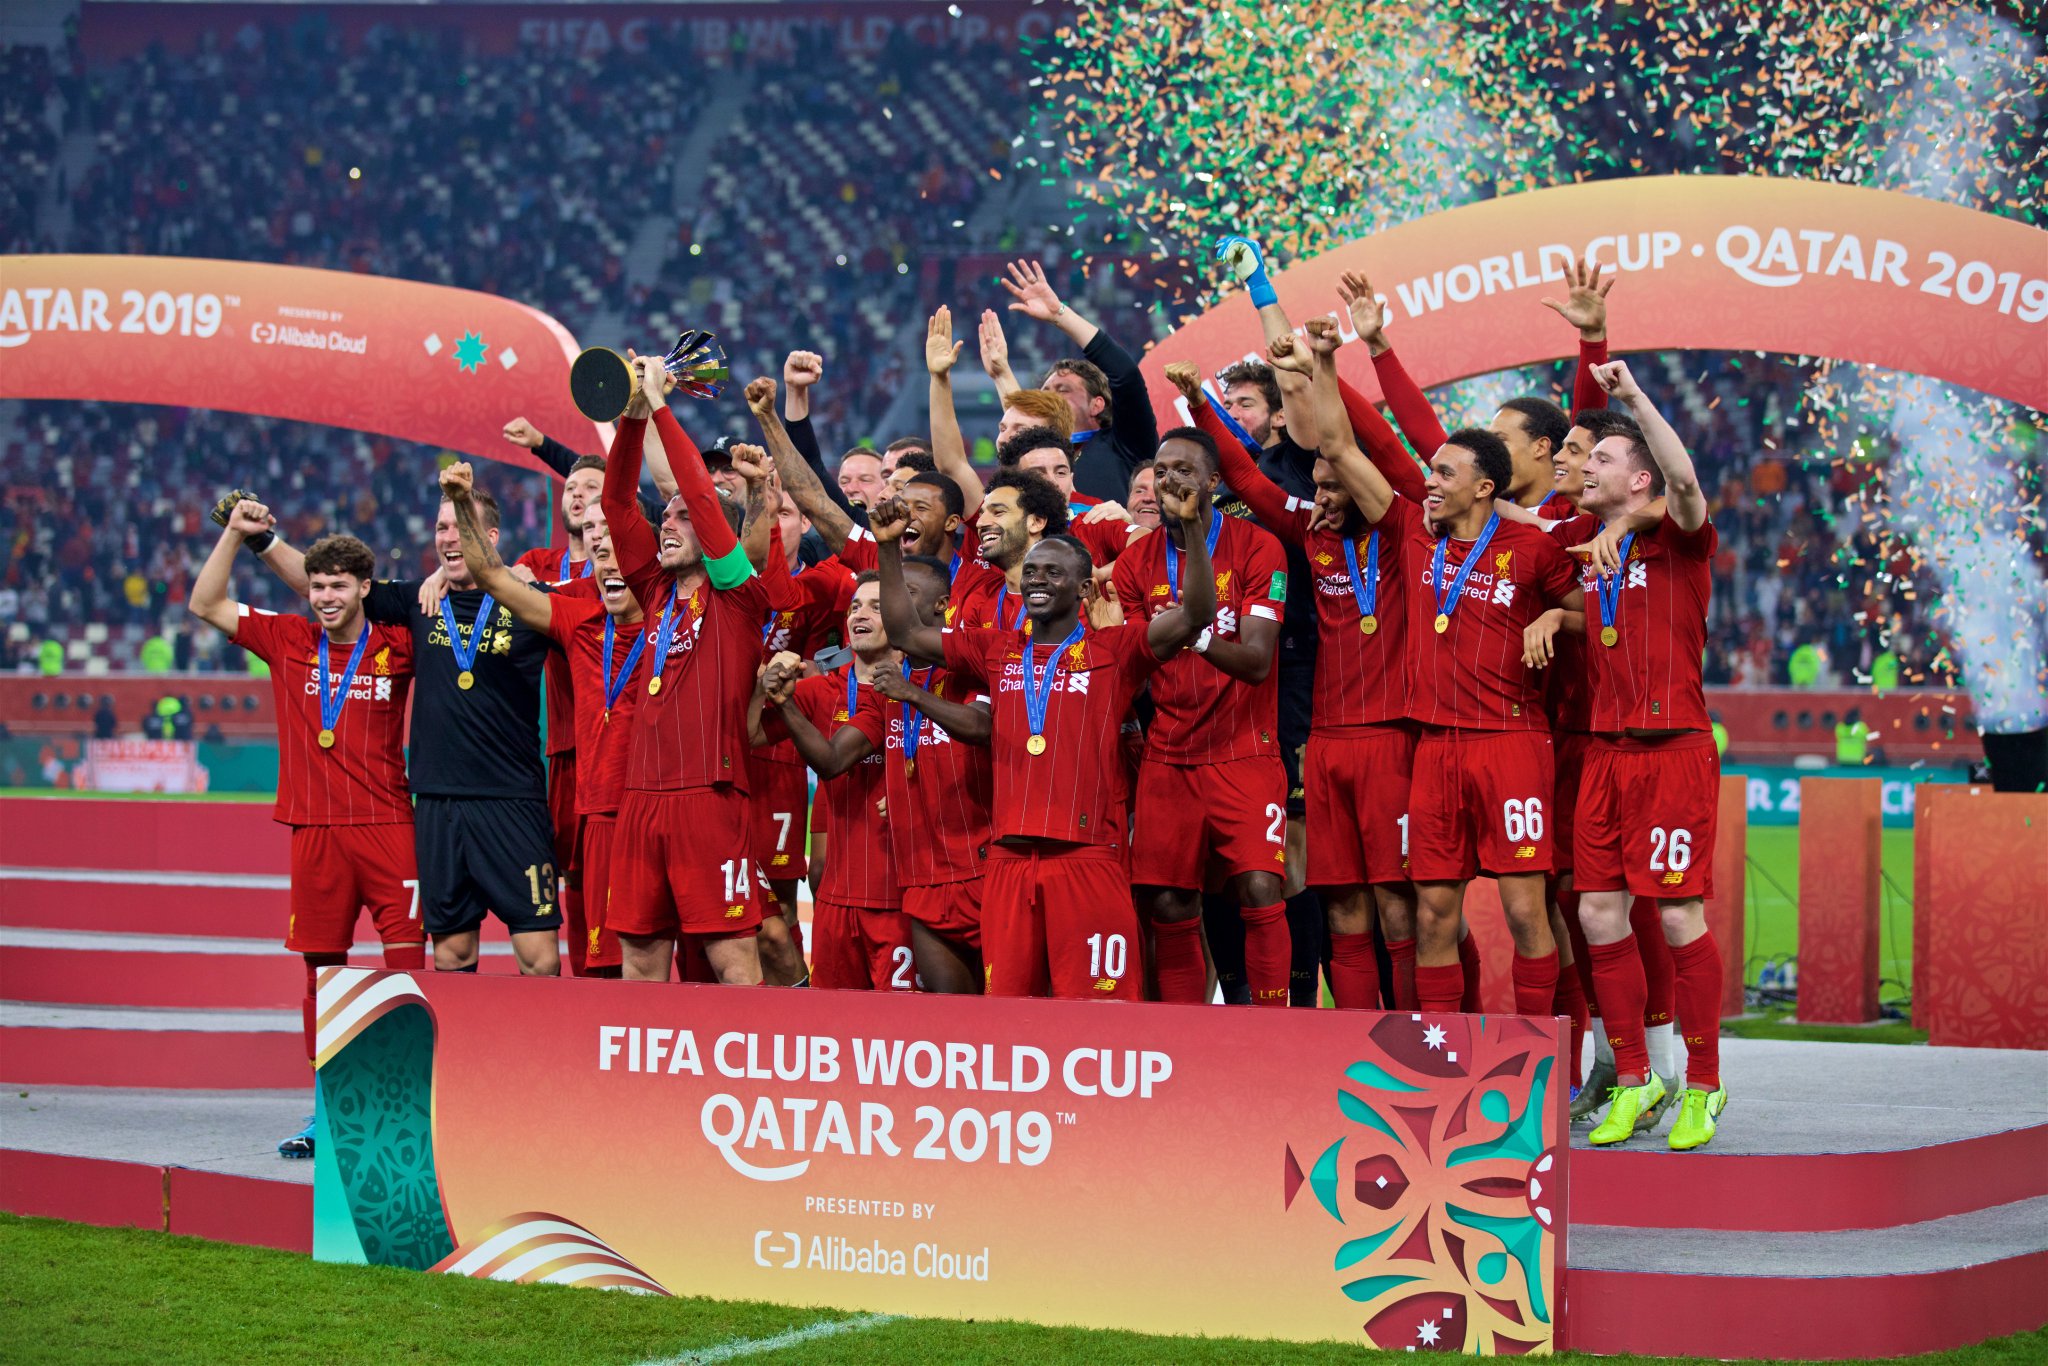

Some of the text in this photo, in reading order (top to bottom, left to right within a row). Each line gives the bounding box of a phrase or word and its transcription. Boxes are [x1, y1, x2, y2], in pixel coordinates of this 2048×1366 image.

[620, 17, 729, 52] CB
[1396, 244, 1575, 318] WORLD
[1585, 231, 1681, 274] CUP
[1716, 225, 1910, 287] QATAR
[1920, 252, 2048, 323] 2019
[0, 288, 113, 347] ATAR
[119, 290, 222, 338] 2019
[278, 325, 367, 354] Alibaba Cloud
[773, 813, 792, 851] 7
[1266, 803, 1287, 848] 2
[1504, 797, 1543, 842] 66
[1650, 826, 1692, 871] 26
[403, 880, 419, 919] 7
[525, 862, 556, 905] 13
[721, 858, 750, 902] 14
[891, 946, 925, 988] 2
[1087, 933, 1127, 978] 10
[599, 1026, 1173, 1098] FIFA CLUB WORLD CUP
[701, 1094, 901, 1181] QATAR
[914, 1106, 1052, 1166] 2019
[805, 1196, 935, 1220] PRESENTED BY
[807, 1236, 989, 1281] Alibaba Cloud
